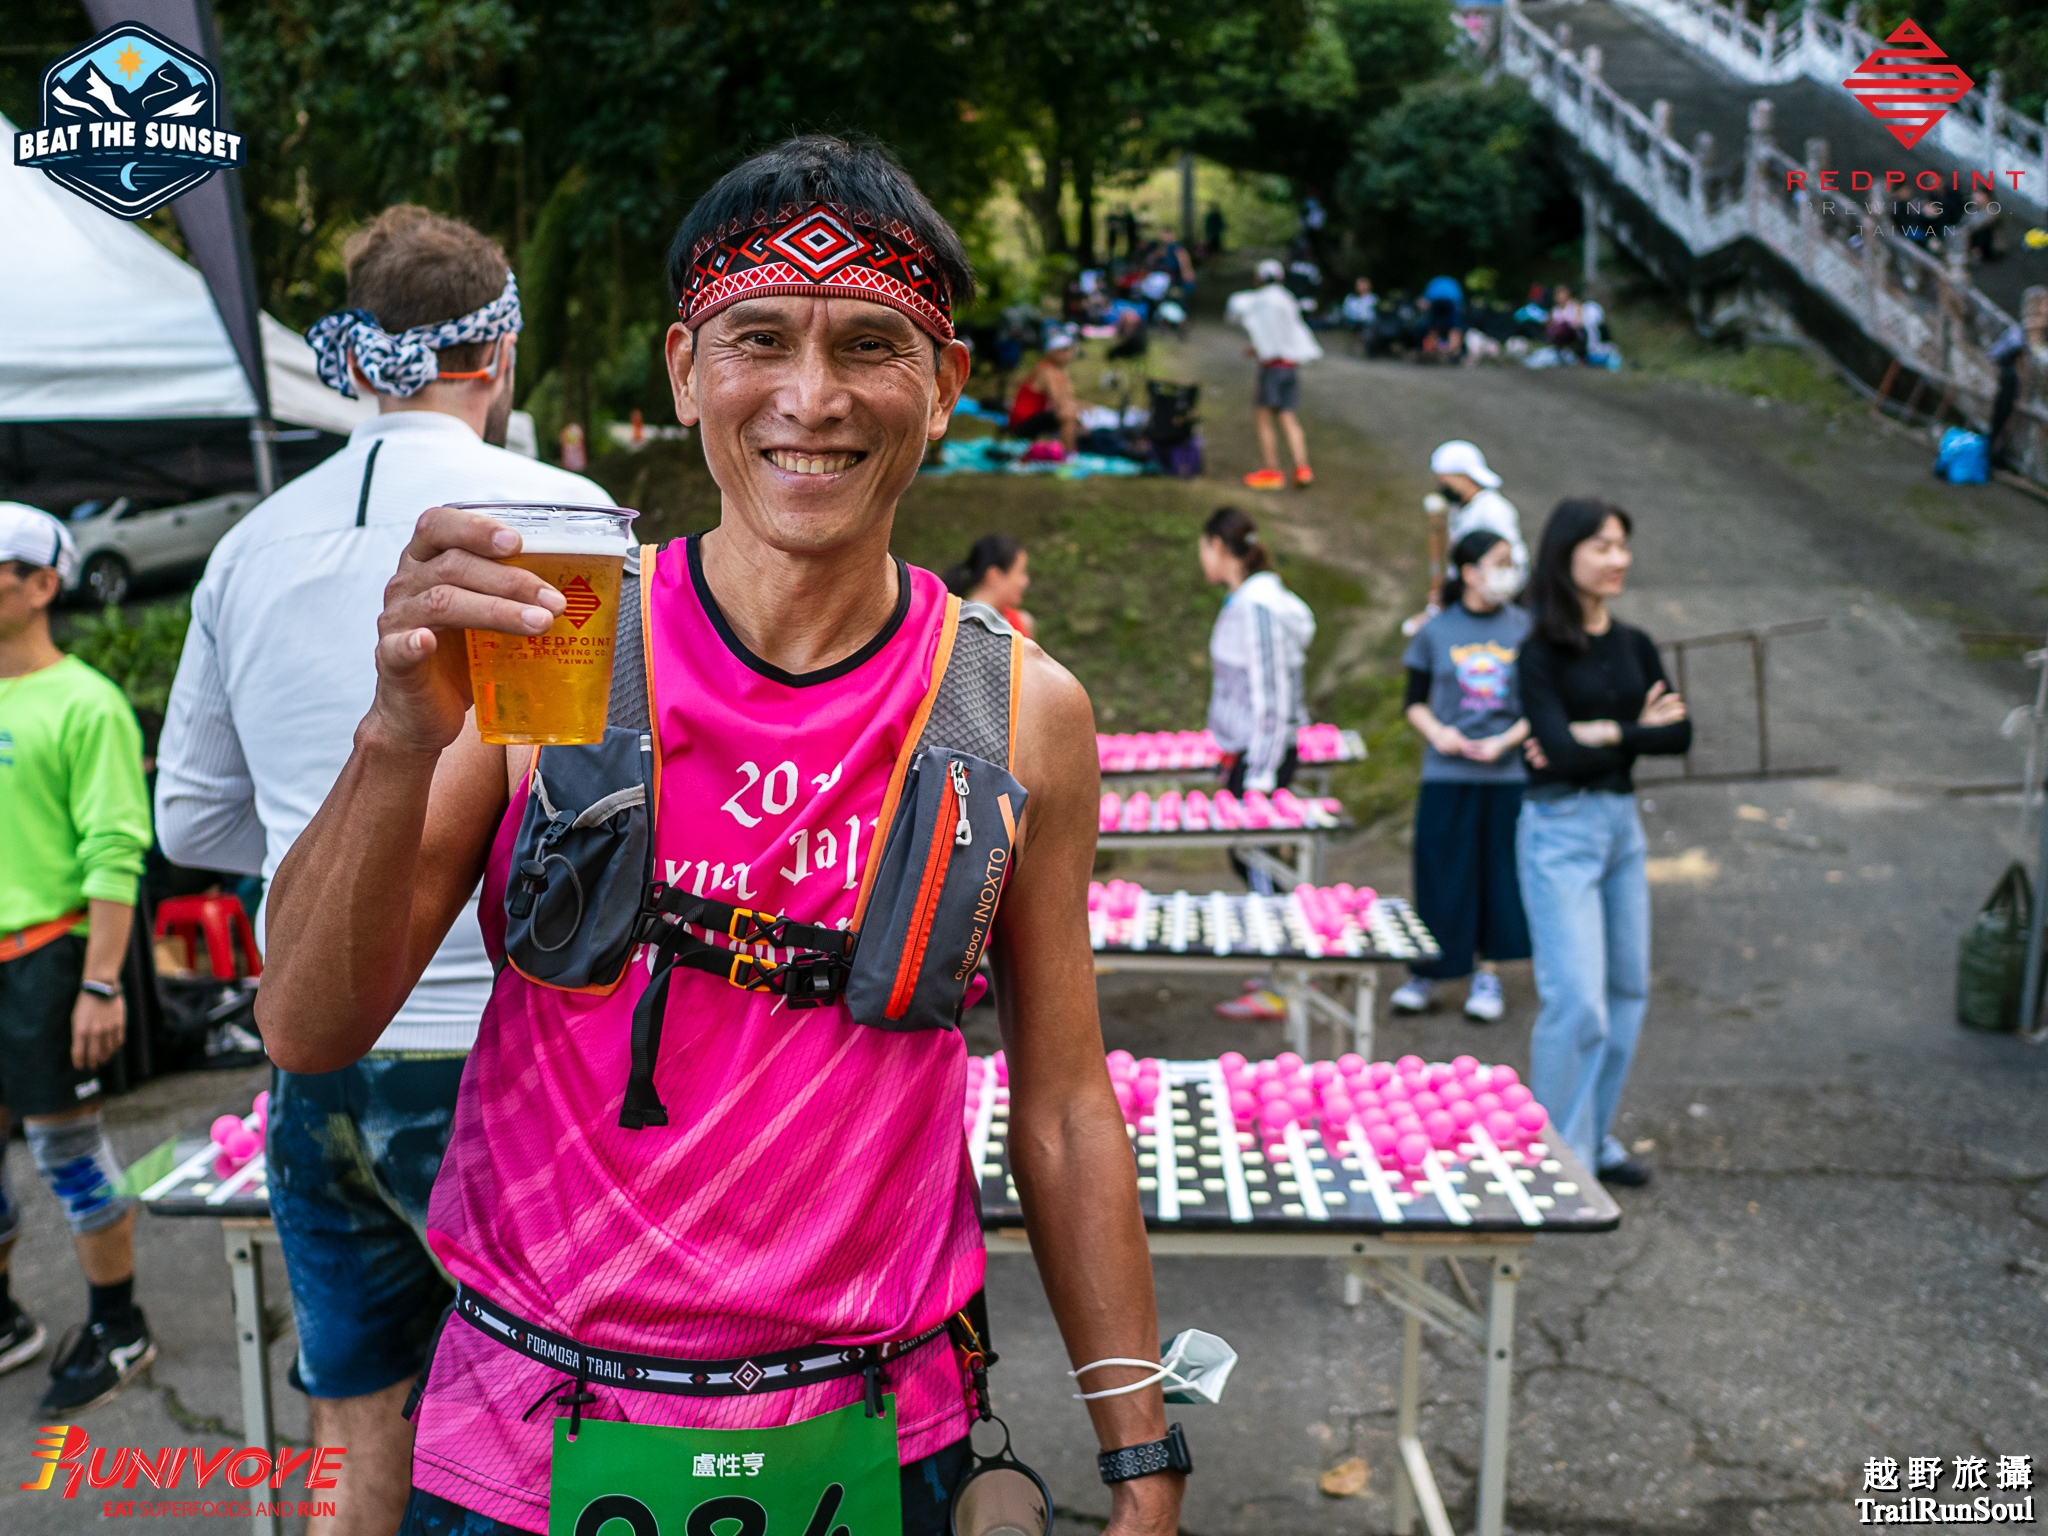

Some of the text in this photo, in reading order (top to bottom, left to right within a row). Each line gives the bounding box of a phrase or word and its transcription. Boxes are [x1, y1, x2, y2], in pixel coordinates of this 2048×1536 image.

[527, 635, 611, 647] REDPOINT
[534, 648, 591, 656] BREWING
[720, 760, 799, 828] 20
[954, 847, 1007, 981] outdoor INOXTO
[526, 1333, 626, 1380] FORMOSA TRAIL
[691, 1452, 766, 1478] 盧性亨
